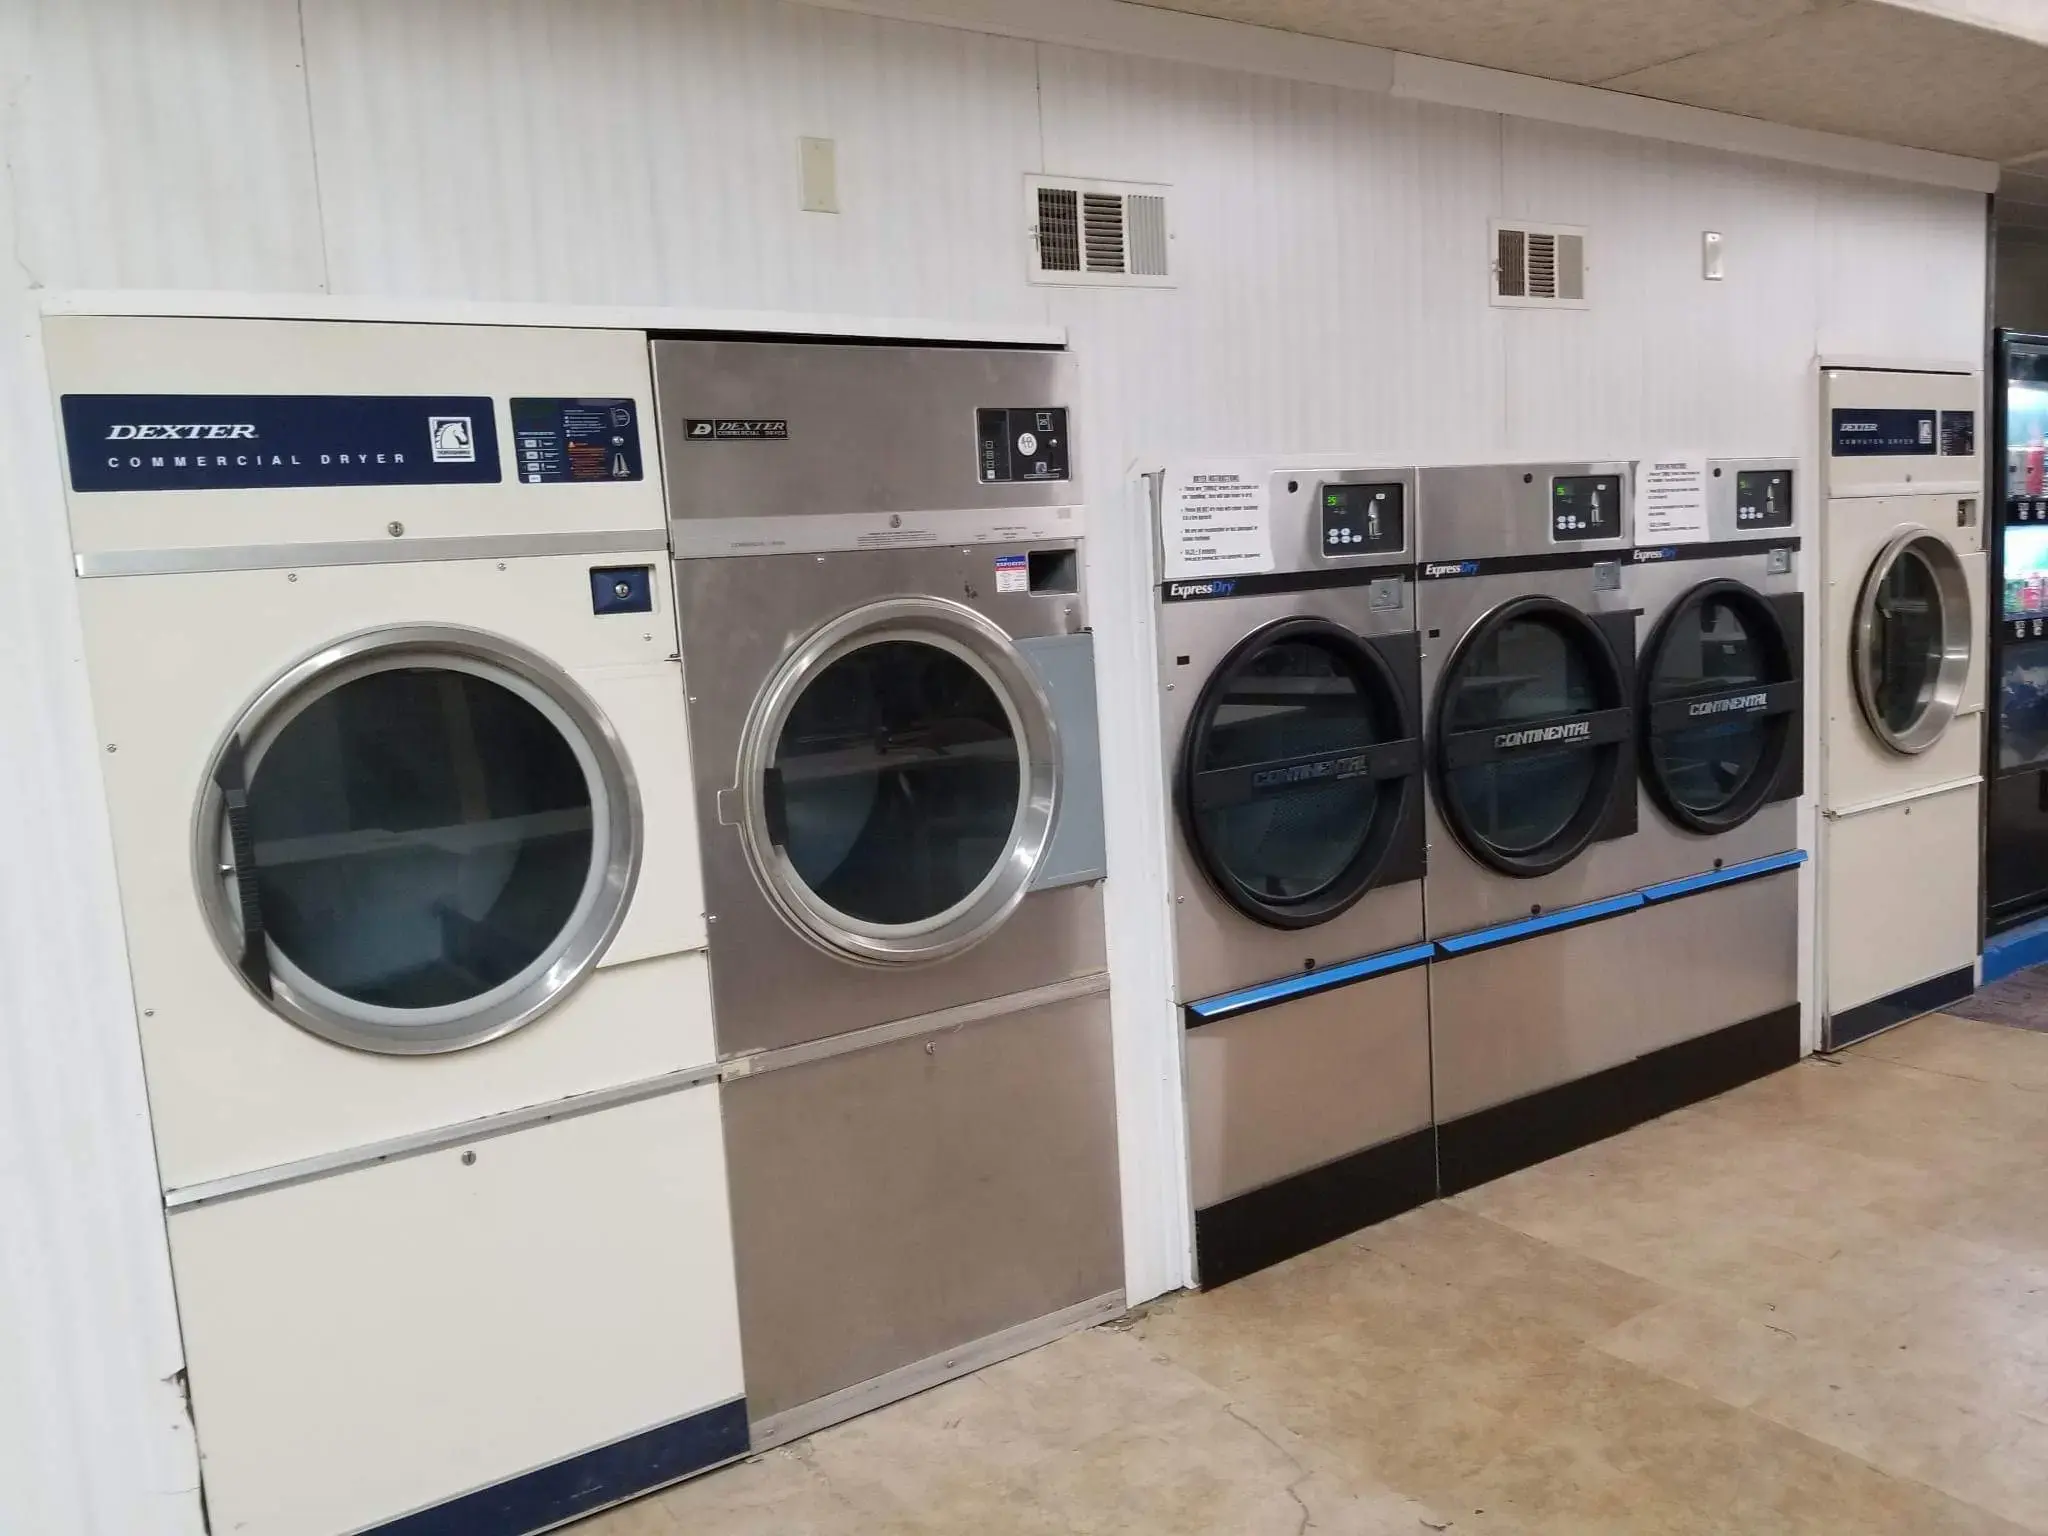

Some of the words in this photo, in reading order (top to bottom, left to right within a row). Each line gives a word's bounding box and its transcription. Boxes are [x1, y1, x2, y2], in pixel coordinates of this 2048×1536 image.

[105, 424, 257, 440] DEXTER
[718, 421, 786, 431] DEXTER
[1839, 423, 1878, 432] DEXTER
[107, 454, 301, 468] COMMERCIAL
[320, 453, 405, 465] DRYER
[1170, 580, 1234, 599] ExpressDry
[1688, 693, 1768, 716] CONTINENTAL
[1494, 721, 1591, 749] CONTINENTAL
